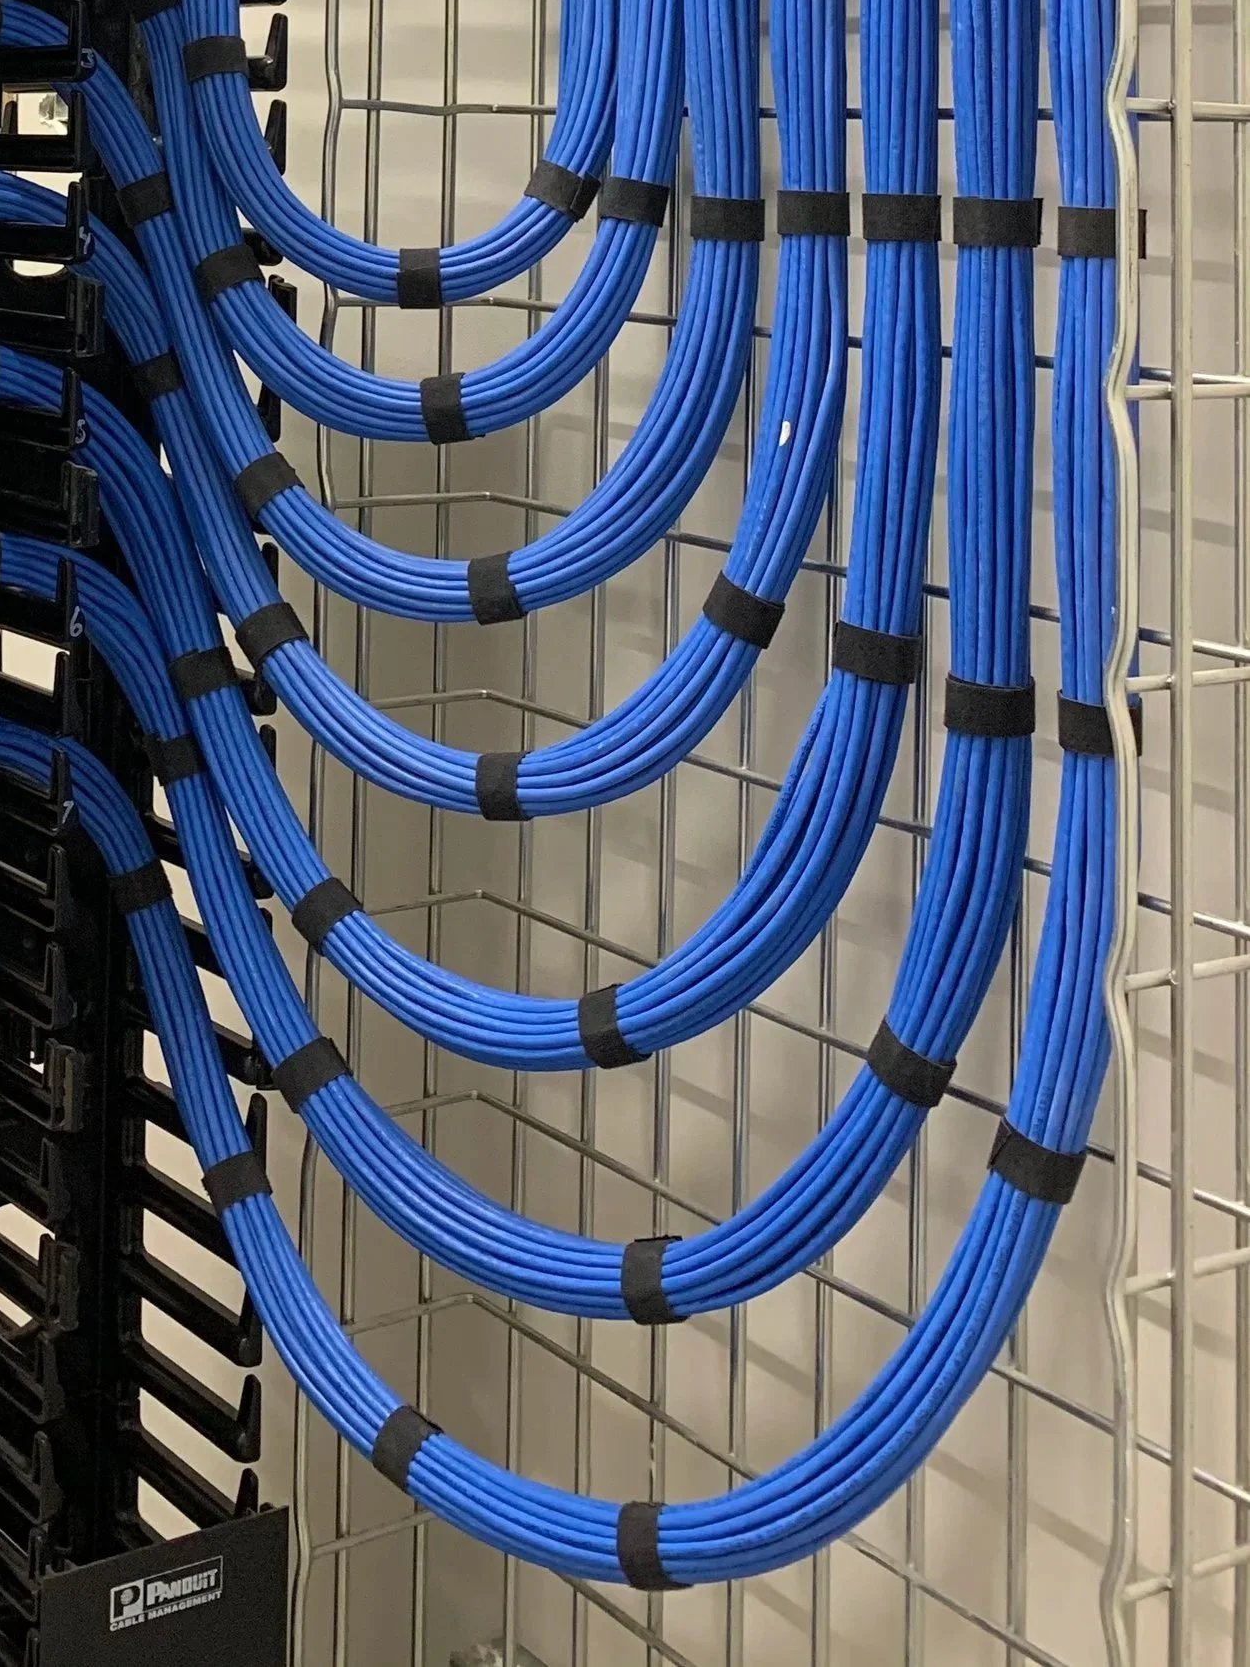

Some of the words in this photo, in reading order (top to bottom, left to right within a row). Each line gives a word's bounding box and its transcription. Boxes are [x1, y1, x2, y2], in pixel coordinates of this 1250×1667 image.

[79, 225, 92, 255] 4
[75, 418, 86, 444] 5
[69, 605, 83, 637] 6
[62, 800, 74, 824] 7
[146, 1568, 218, 1606] PANDUIT
[110, 1614, 145, 1632] CABLE
[148, 1590, 223, 1620] MANAGEMENT
